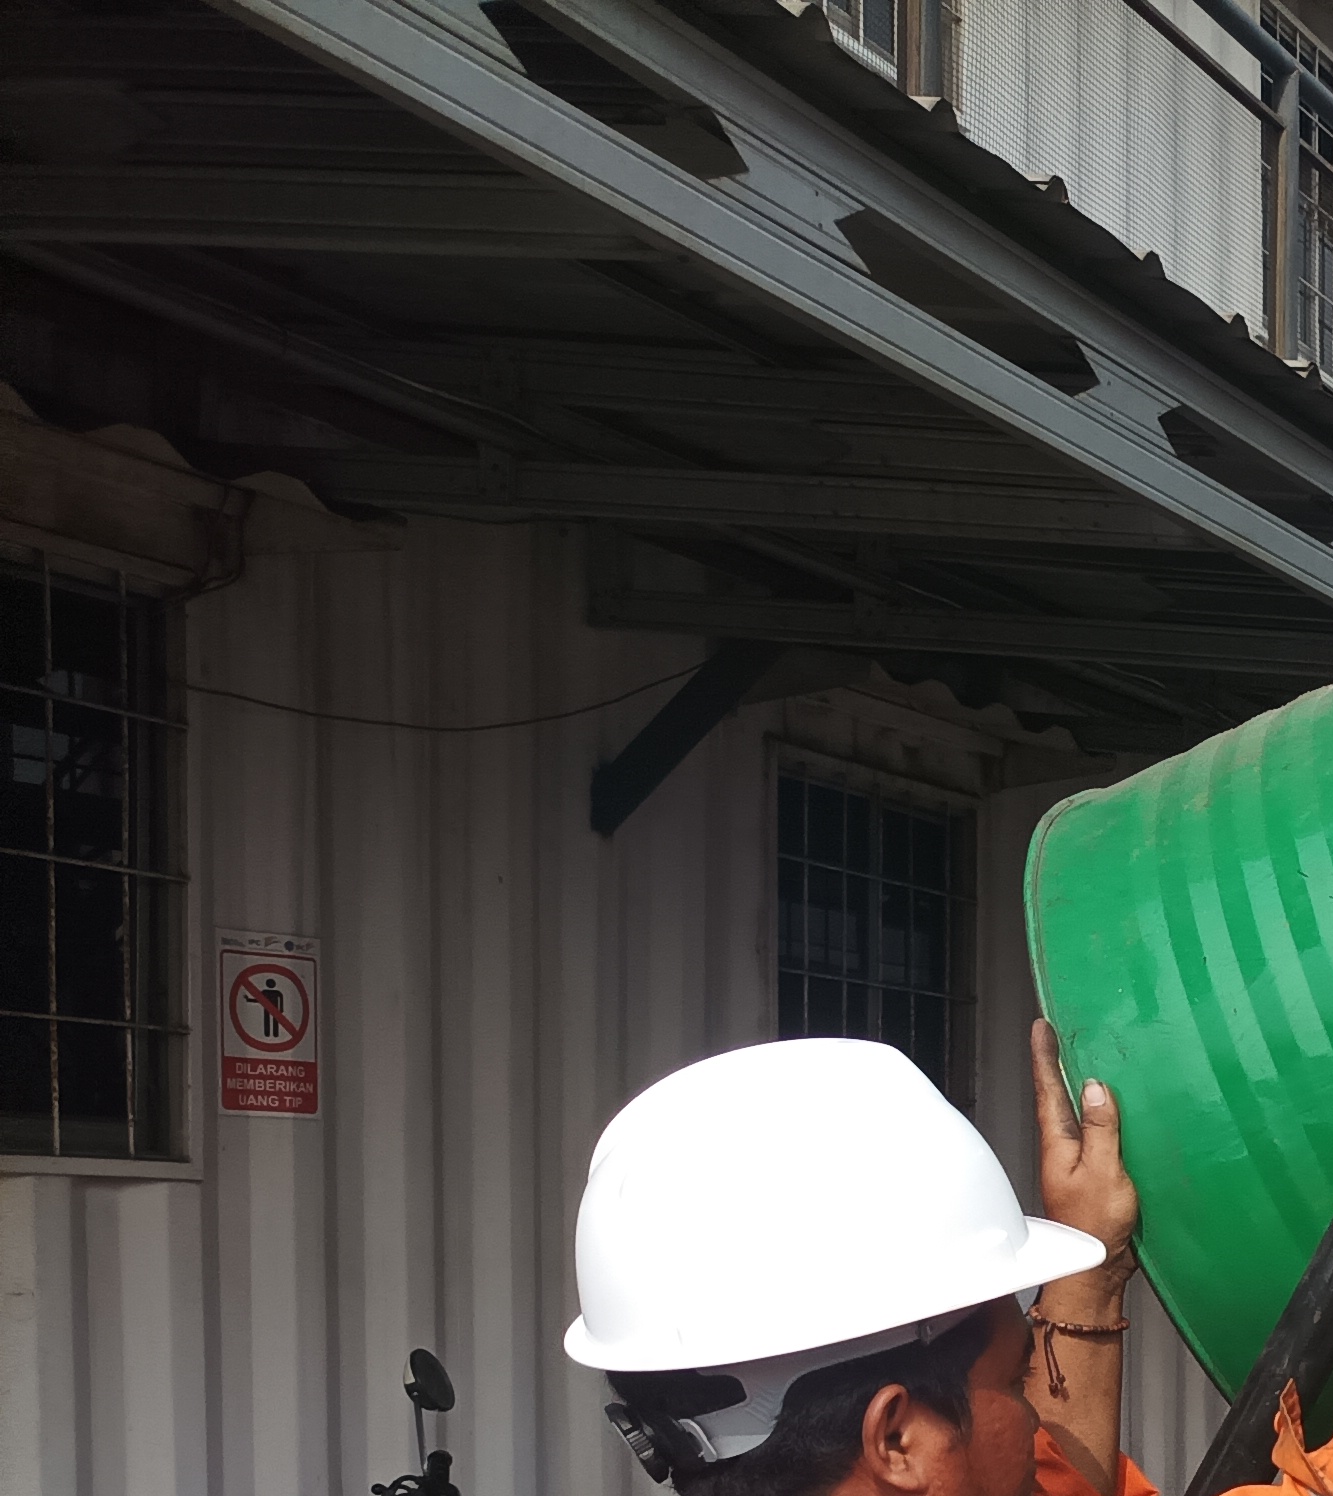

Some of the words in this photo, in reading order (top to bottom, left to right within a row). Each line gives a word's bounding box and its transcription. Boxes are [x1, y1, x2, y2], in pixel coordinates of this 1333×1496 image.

[236, 1062, 305, 1077] DILARANG
[227, 1078, 313, 1093] MEMBERIKAN
[238, 1095, 279, 1107] UANG
[284, 1096, 303, 1108] TIP
